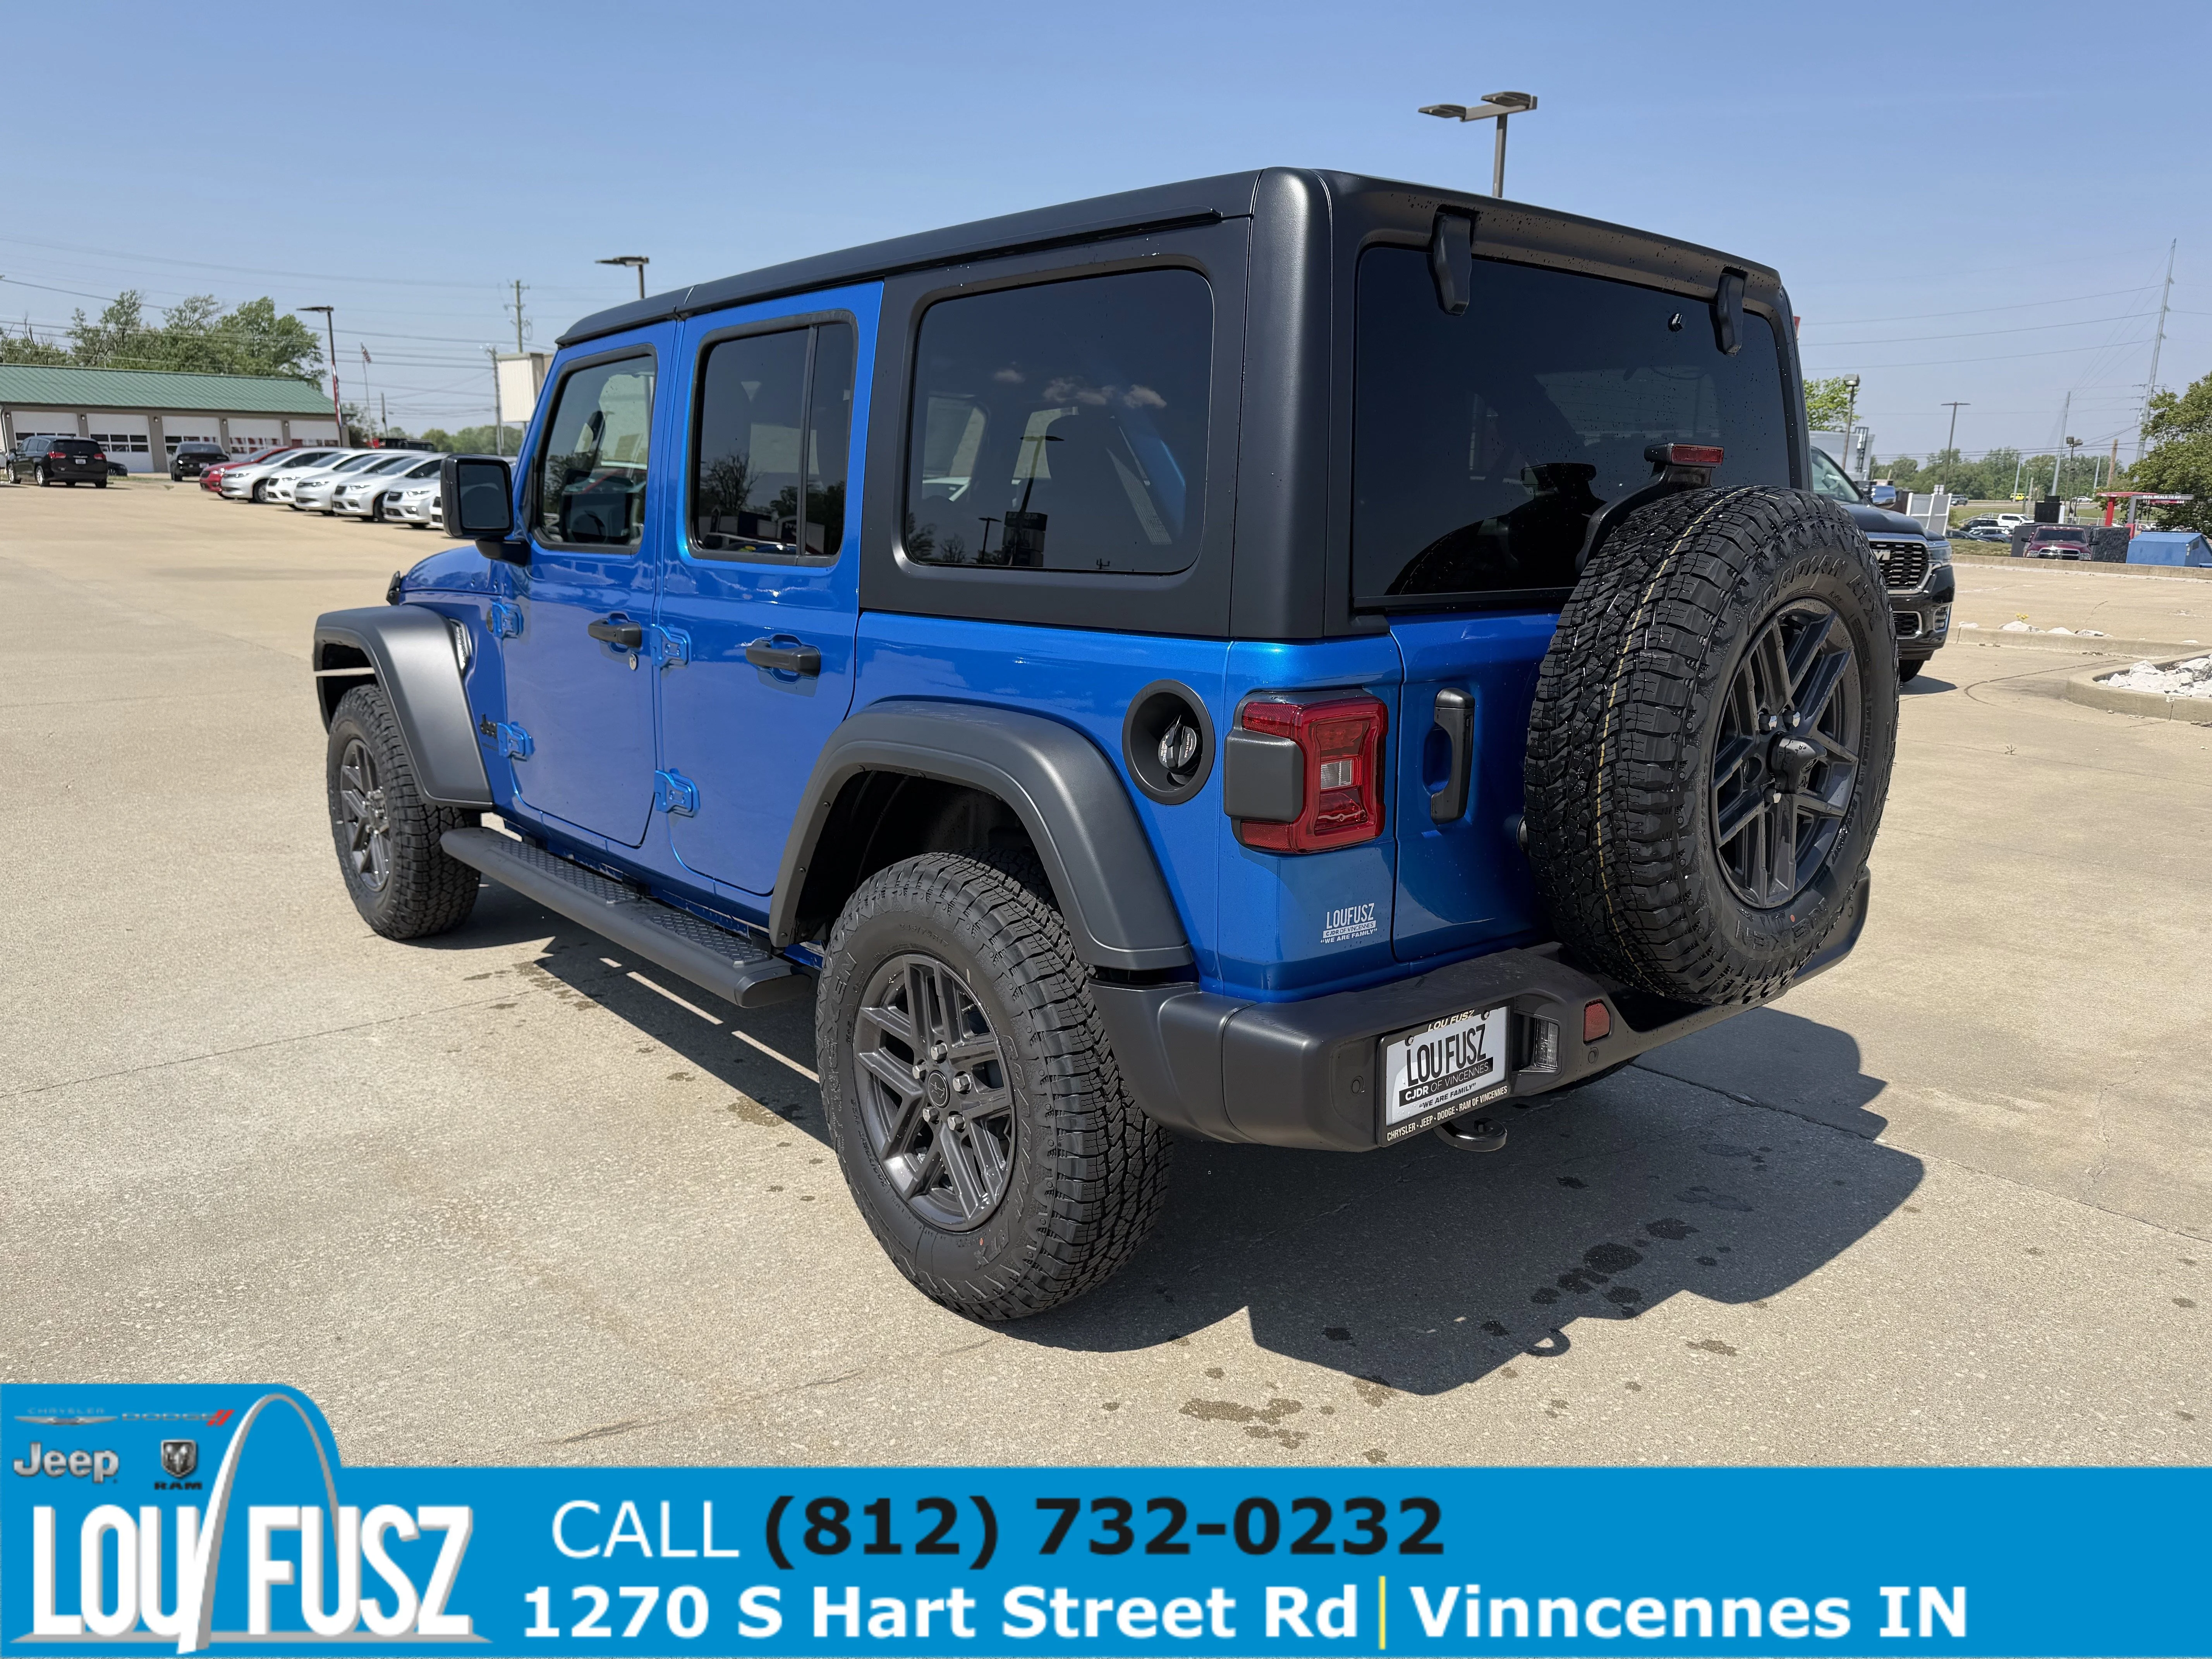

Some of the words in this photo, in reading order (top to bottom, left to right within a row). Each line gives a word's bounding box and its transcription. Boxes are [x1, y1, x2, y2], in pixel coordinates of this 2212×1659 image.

[1348, 922, 1374, 933] VINCENNES
[1428, 1018, 1448, 1032] LOU
[1450, 1010, 1475, 1024] FUSZ
[1407, 1040, 1443, 1087] LOU
[1446, 1024, 1486, 1074] FUSZ
[1405, 1084, 1429, 1101] CJDR
[1431, 1079, 1444, 1092] OF
[1444, 1061, 1489, 1087] VINCENNES
[1387, 1122, 1416, 1142] CHRYSLER
[1420, 1116, 1433, 1128] JEEP
[1437, 1107, 1456, 1121] DODGE
[1459, 1099, 1471, 1112] RAM
[1472, 1097, 1479, 1108] OF
[1479, 1086, 1508, 1104] VINCENNES
[1435, 1094, 1448, 1104] ARE
